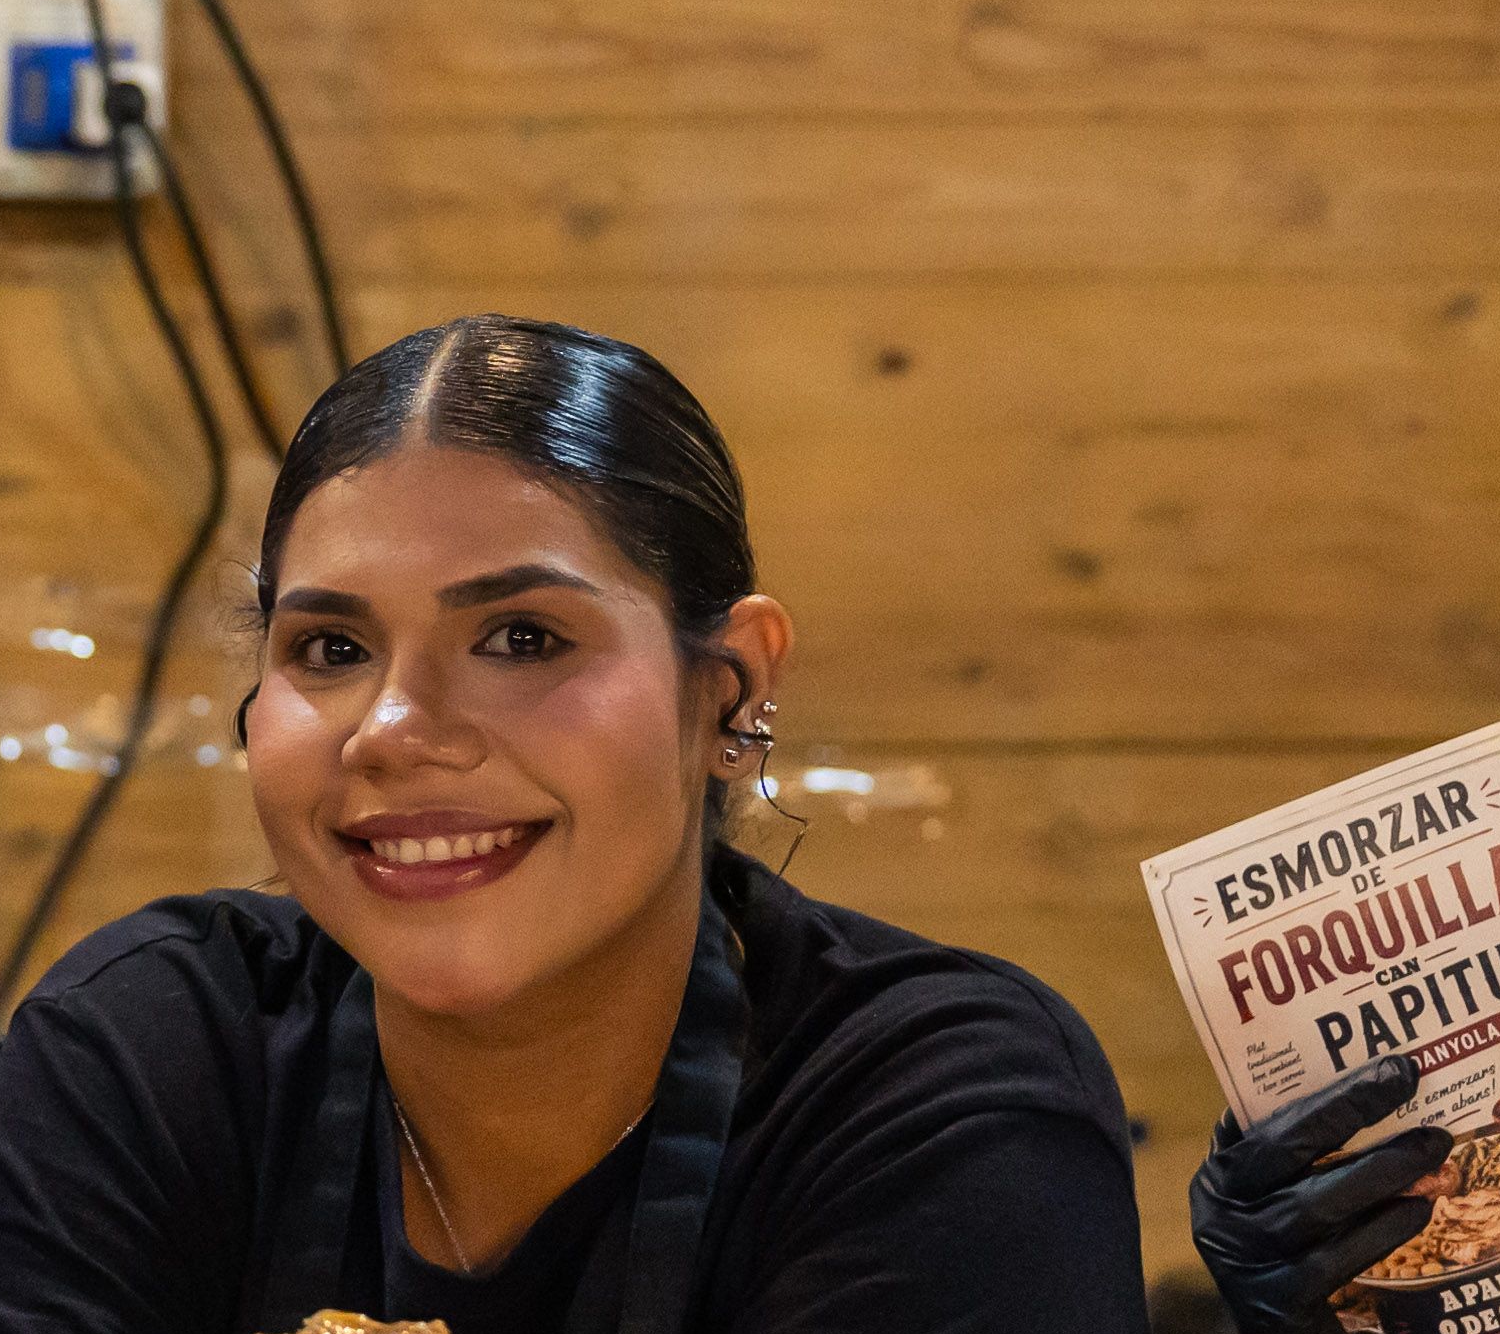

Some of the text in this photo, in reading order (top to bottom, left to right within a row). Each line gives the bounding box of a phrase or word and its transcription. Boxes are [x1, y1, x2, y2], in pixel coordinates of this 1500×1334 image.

[1214, 780, 1479, 924] ESMORZAR
[1351, 866, 1386, 895] DE
[1375, 957, 1421, 986] CAN
[1425, 1063, 1496, 1105] esmorzars
[1420, 1078, 1496, 1128] com abans!
[1440, 1290, 1463, 1313] A
